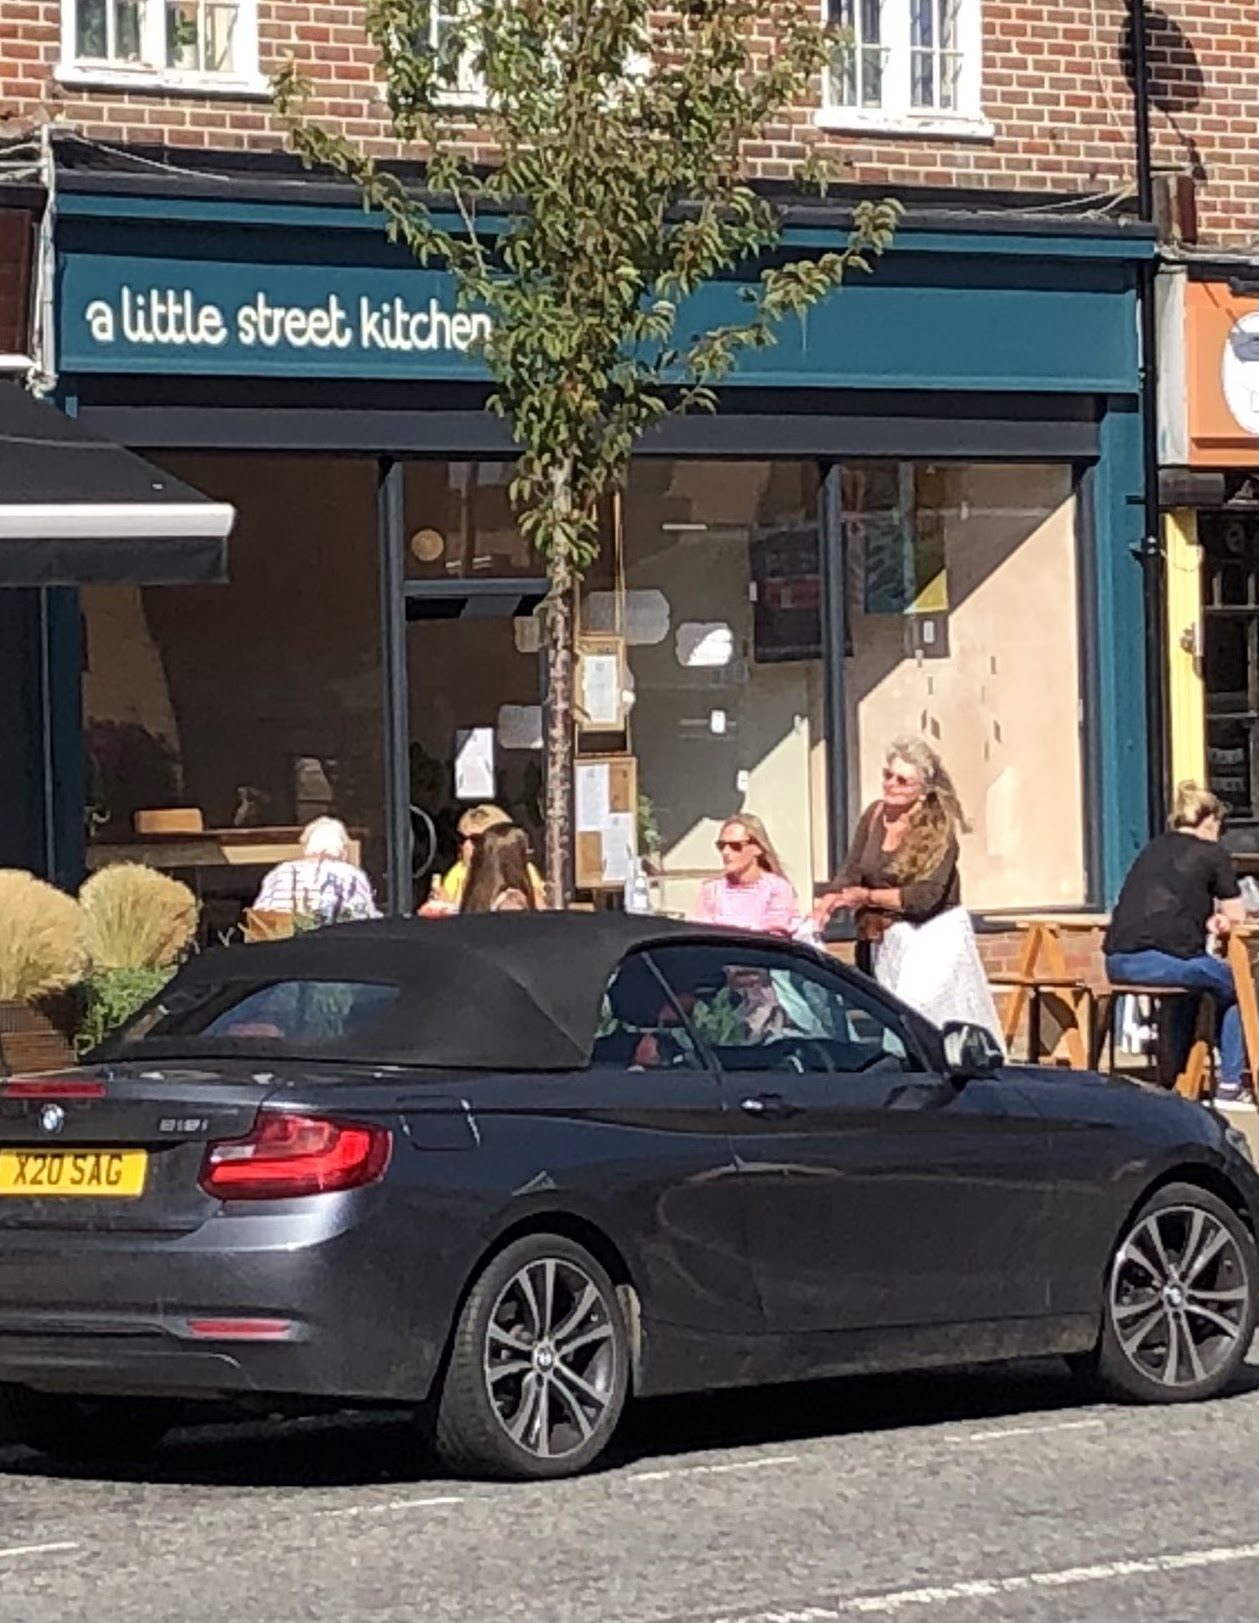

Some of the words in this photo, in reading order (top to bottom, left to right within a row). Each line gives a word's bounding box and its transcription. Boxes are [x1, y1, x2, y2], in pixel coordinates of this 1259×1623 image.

[85, 300, 114, 342] a
[121, 285, 228, 345] little
[236, 292, 354, 348] street
[359, 296, 493, 353] kitchen
[13, 1152, 63, 1185] X20
[70, 1152, 123, 1185] SAG
